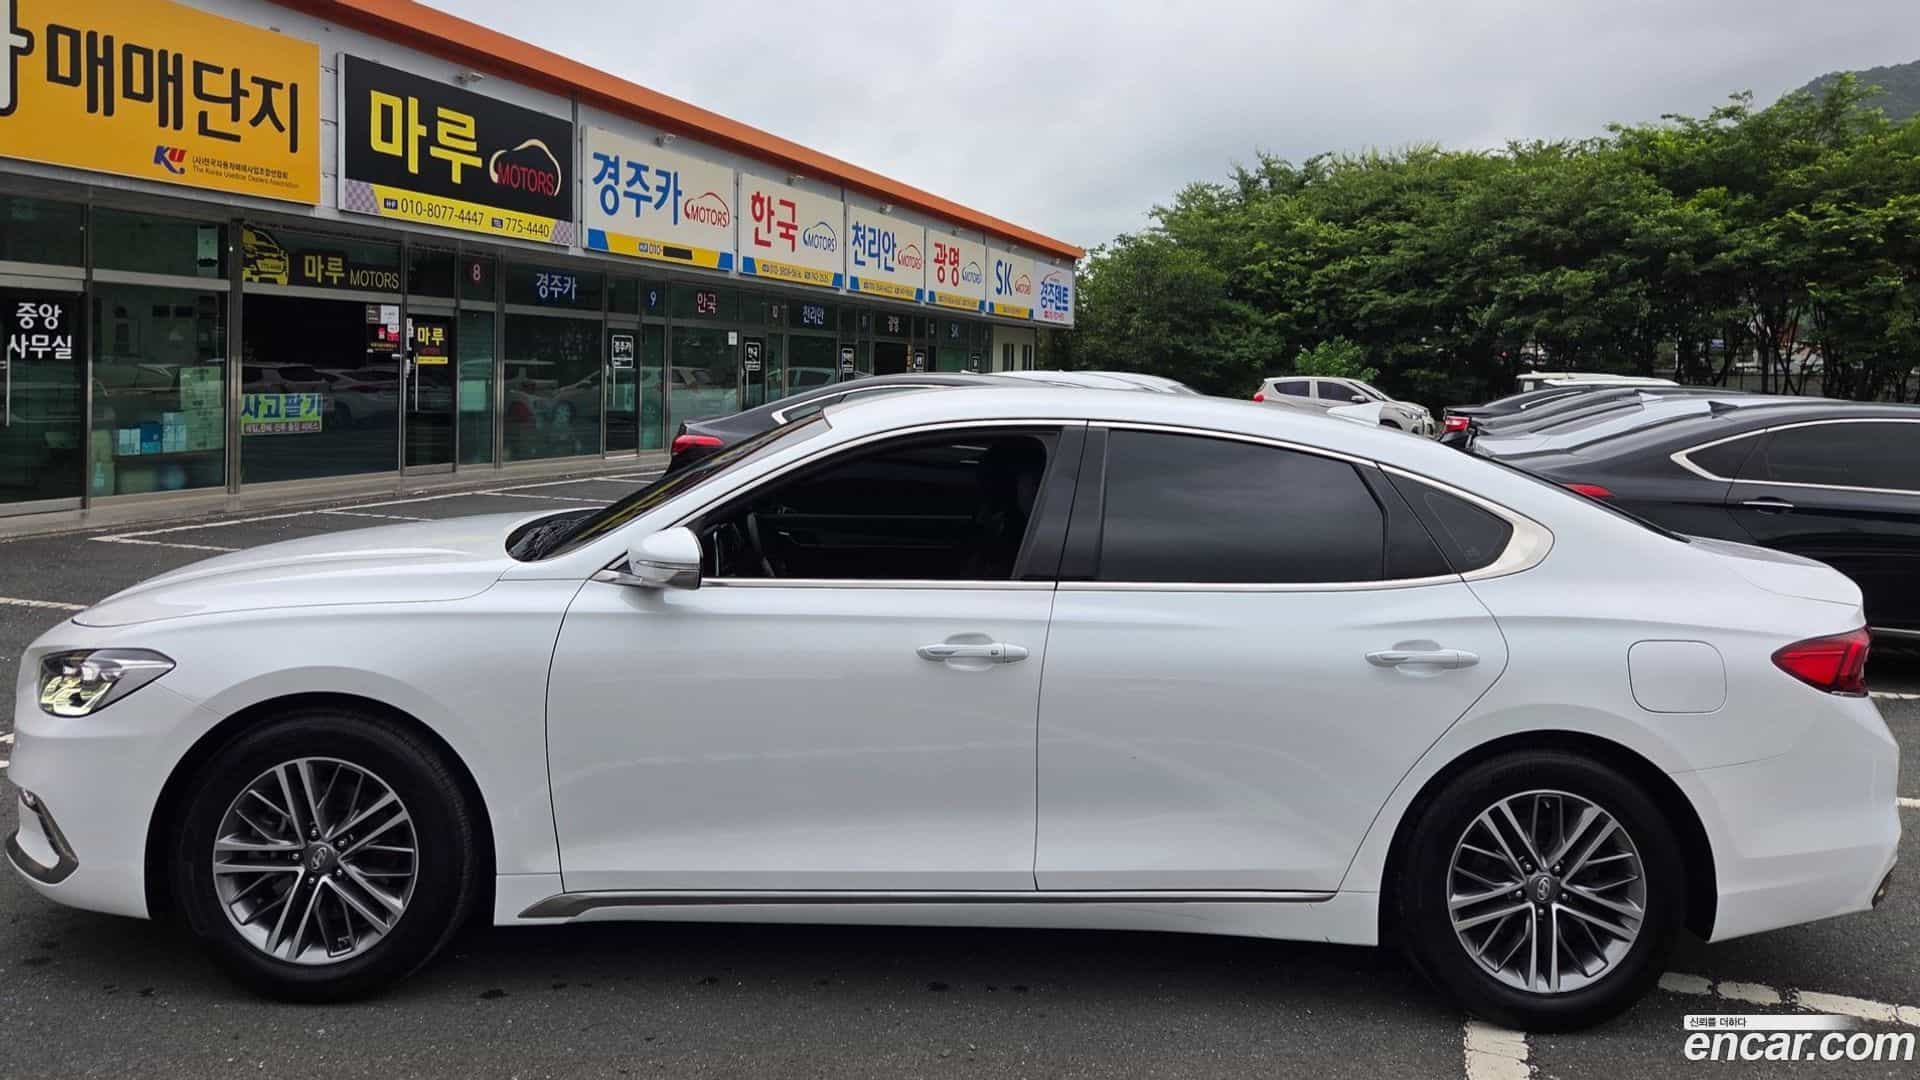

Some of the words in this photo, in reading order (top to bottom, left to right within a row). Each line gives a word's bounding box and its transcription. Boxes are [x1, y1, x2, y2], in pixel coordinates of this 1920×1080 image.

[46, 23, 298, 153] 매매단지
[370, 89, 482, 184] 마루
[498, 162, 554, 195] MOTORS
[592, 152, 682, 225] 경주카
[401, 198, 484, 226] 010-8077-4447
[506, 217, 550, 238] 775-4440
[689, 205, 728, 228] MOTORS
[751, 191, 798, 253] 한국
[807, 233, 835, 253] MOTORS
[852, 221, 896, 272] 천리안
[304, 255, 344, 285] 마루
[472, 263, 481, 281] 8
[901, 253, 922, 270] MOTORS
[934, 242, 960, 287] 광명
[350, 269, 400, 289] MOTORS
[536, 272, 577, 300] 경주카
[996, 259, 1012, 296] SK
[650, 291, 657, 307] 9
[696, 292, 718, 314] 한국
[16, 303, 62, 330] 중앙
[803, 304, 824, 325] 천리안
[9, 334, 72, 360] 사무실
[417, 327, 445, 346] 마루
